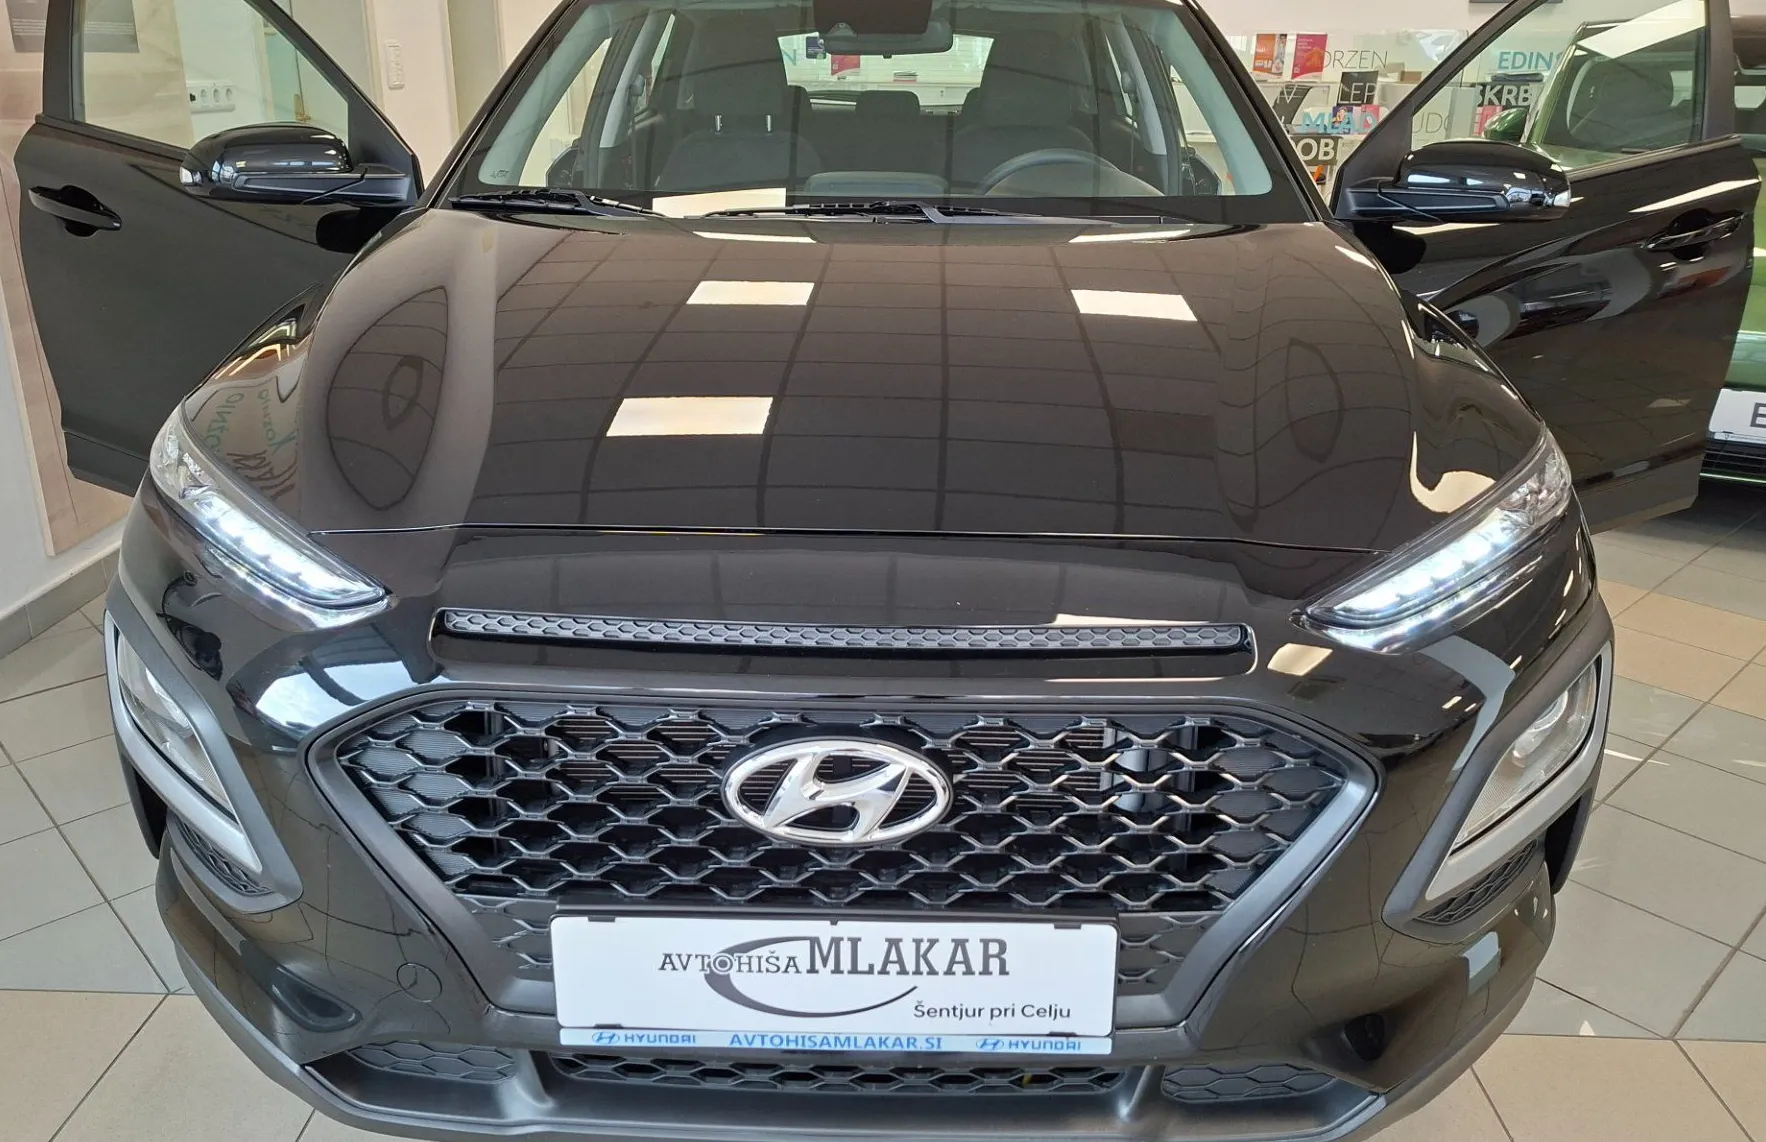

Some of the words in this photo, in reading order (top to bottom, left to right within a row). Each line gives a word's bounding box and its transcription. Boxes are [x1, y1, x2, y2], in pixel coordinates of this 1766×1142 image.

[658, 950, 802, 973] AVTOHIŠA
[806, 937, 1010, 975] MLAKAR
[913, 1000, 984, 1021] Šentjur
[989, 1003, 1016, 1021] pri
[1021, 1003, 1071, 1021] Celju
[624, 1033, 696, 1044] HYUNDAI
[729, 1033, 942, 1049] AVTOHISAMLAKAR.SI
[1008, 1040, 1081, 1051] HYUNDAI
